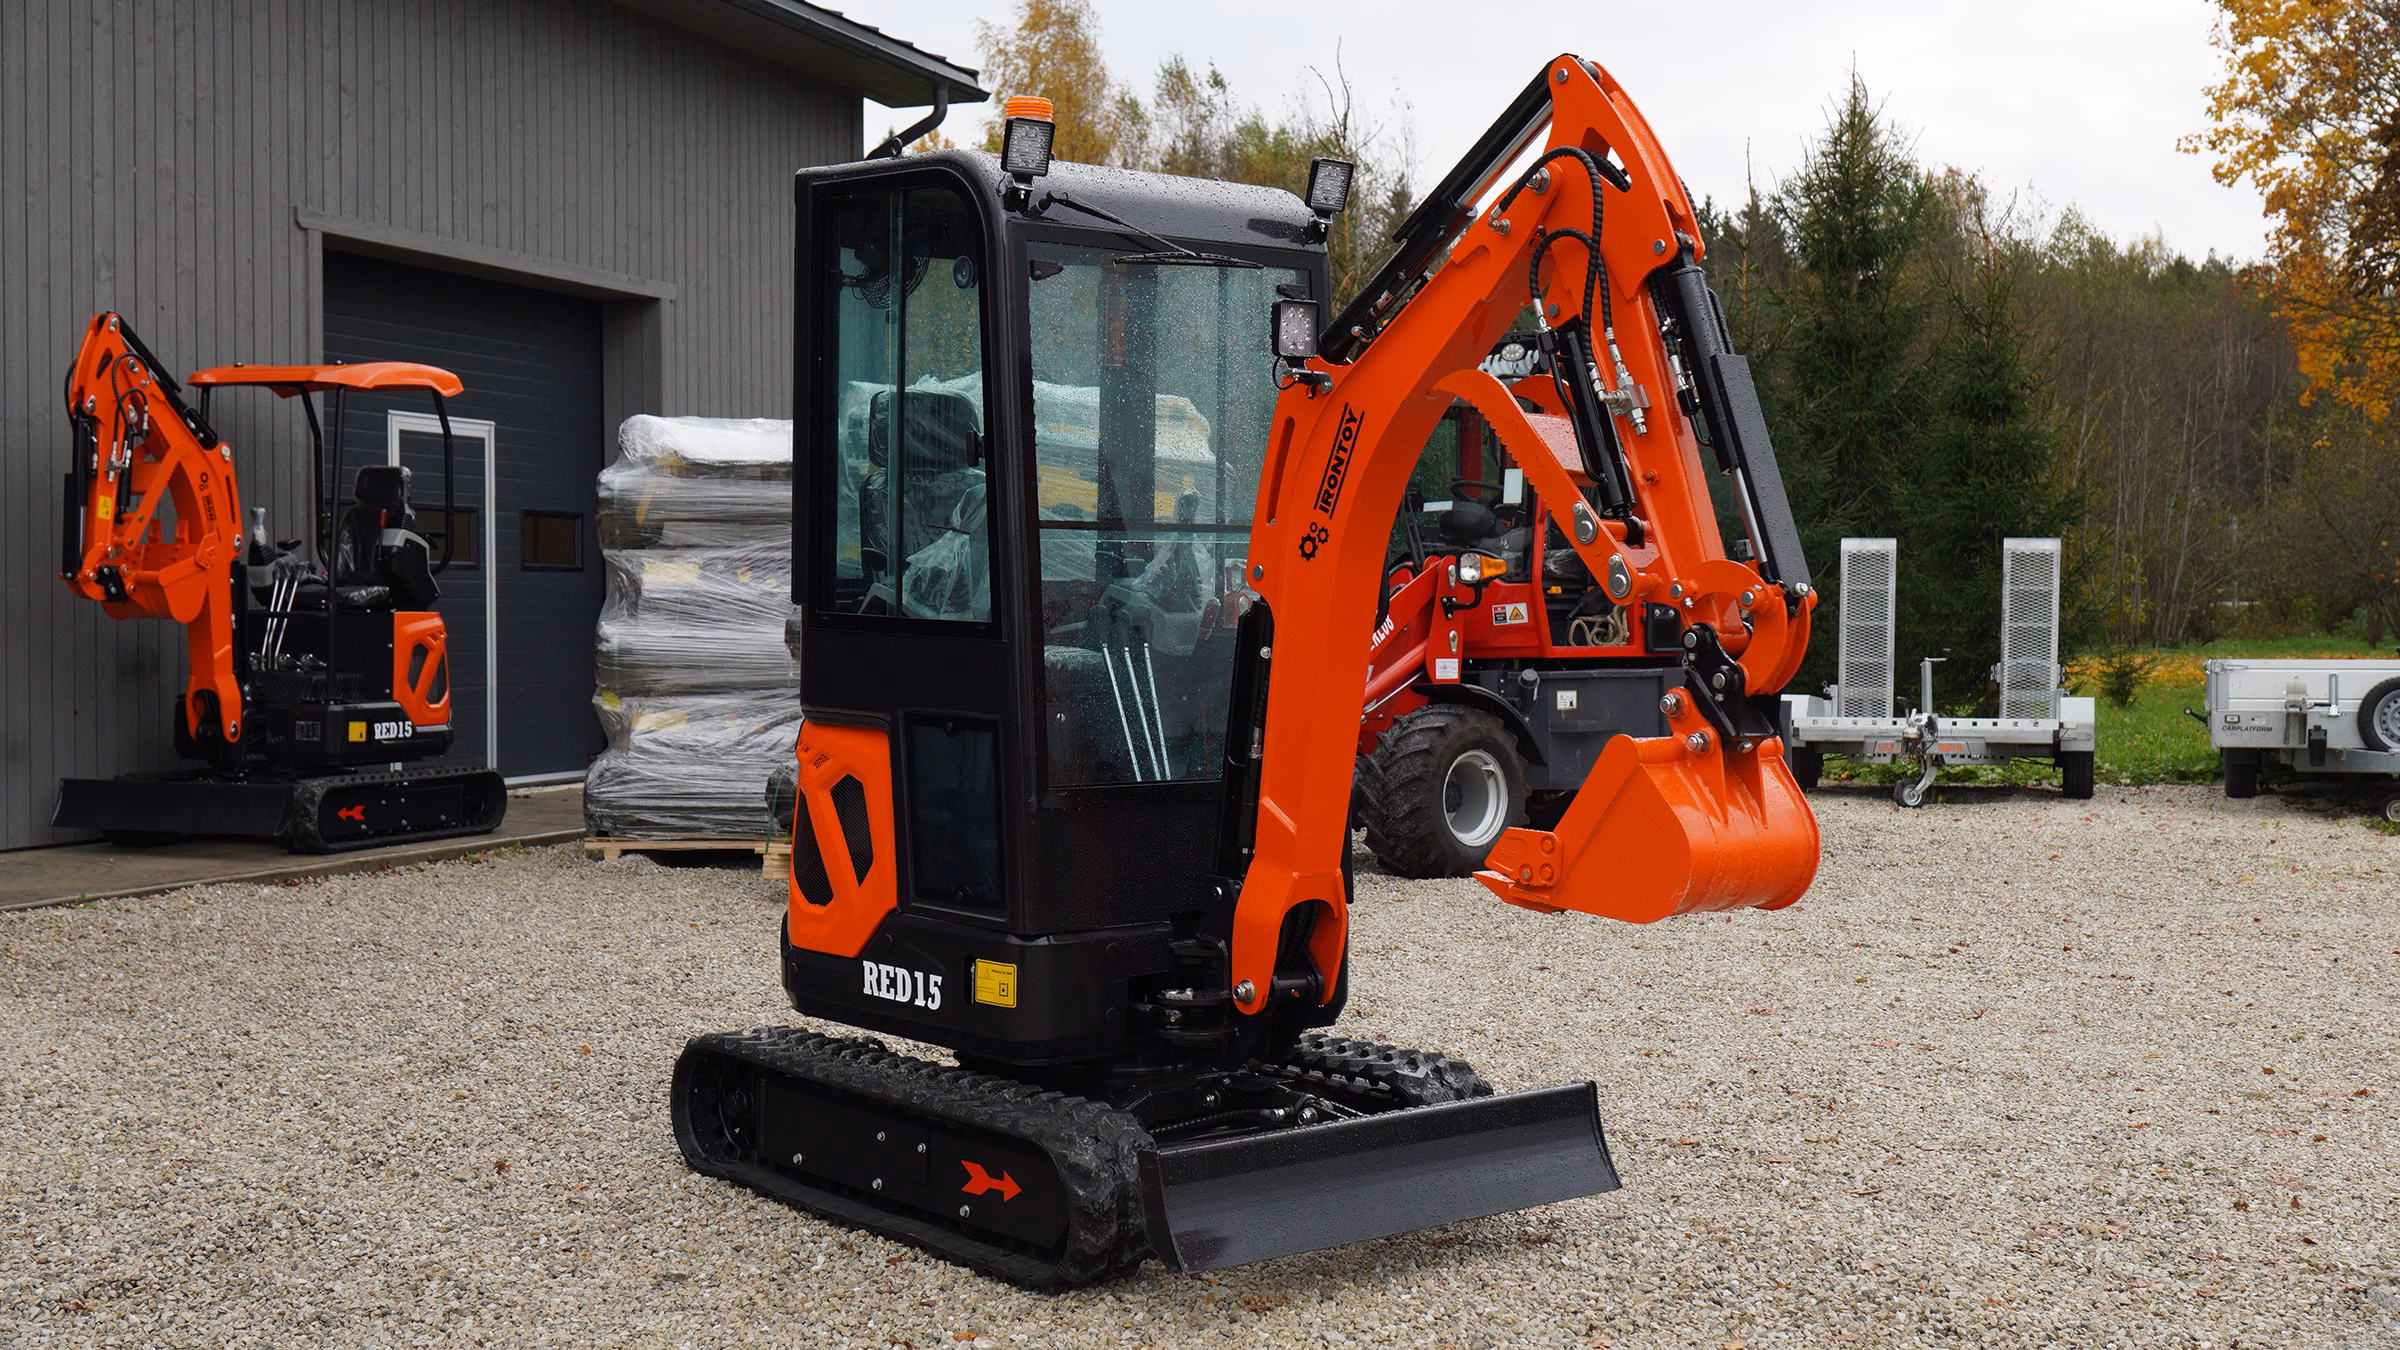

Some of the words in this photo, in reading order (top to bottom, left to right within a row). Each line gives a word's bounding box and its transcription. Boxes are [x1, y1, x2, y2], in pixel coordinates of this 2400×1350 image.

[1319, 407, 1358, 515] IRONTOY
[373, 720, 413, 740] RED15
[862, 960, 943, 1011] RED15
